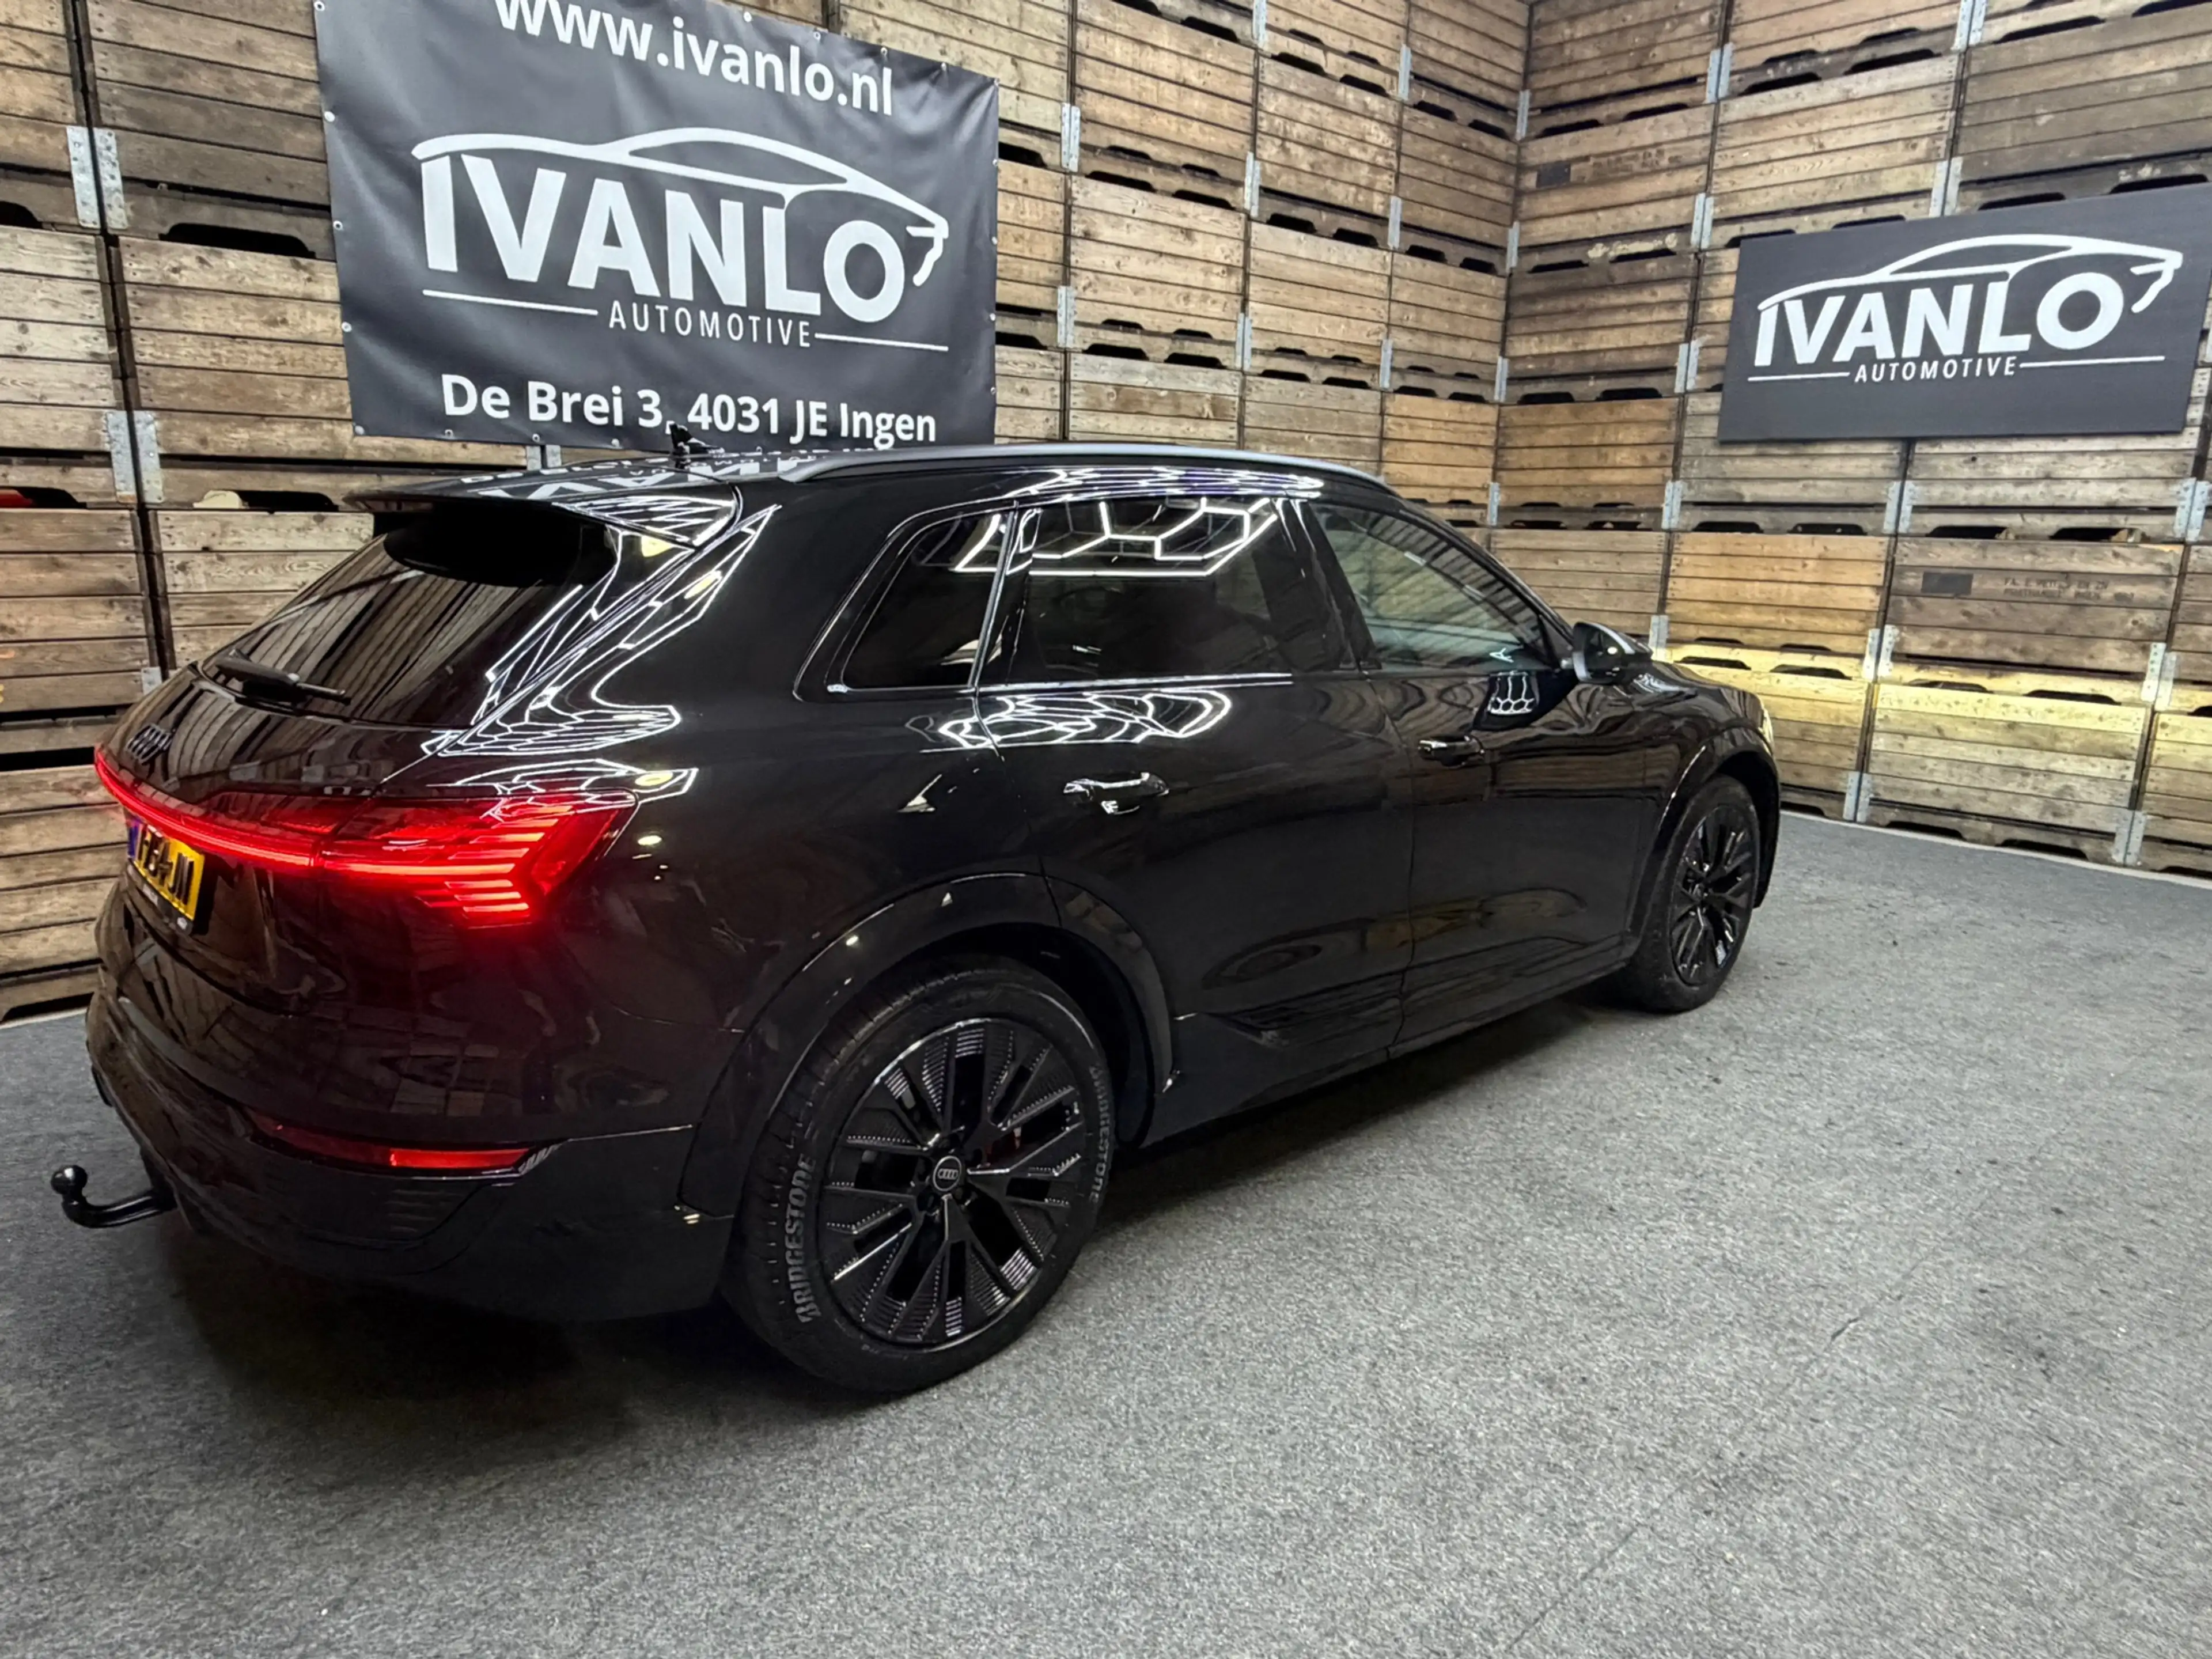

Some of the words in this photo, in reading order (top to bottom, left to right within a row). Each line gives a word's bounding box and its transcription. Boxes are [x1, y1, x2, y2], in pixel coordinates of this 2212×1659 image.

[495, 0, 892, 115] www.ivanlo.nl
[421, 154, 905, 323] IVANLO
[609, 300, 810, 347] AUTOMOTIVE
[1754, 271, 2124, 367] IVANLO
[441, 373, 512, 419] De
[528, 380, 623, 426] Brei
[688, 393, 779, 434] 4031
[790, 400, 827, 445] JE
[840, 403, 936, 450] Ingen
[1854, 355, 2016, 383] AUTOMOTIVE
[784, 1153, 821, 1323] BRIDGESTONE
